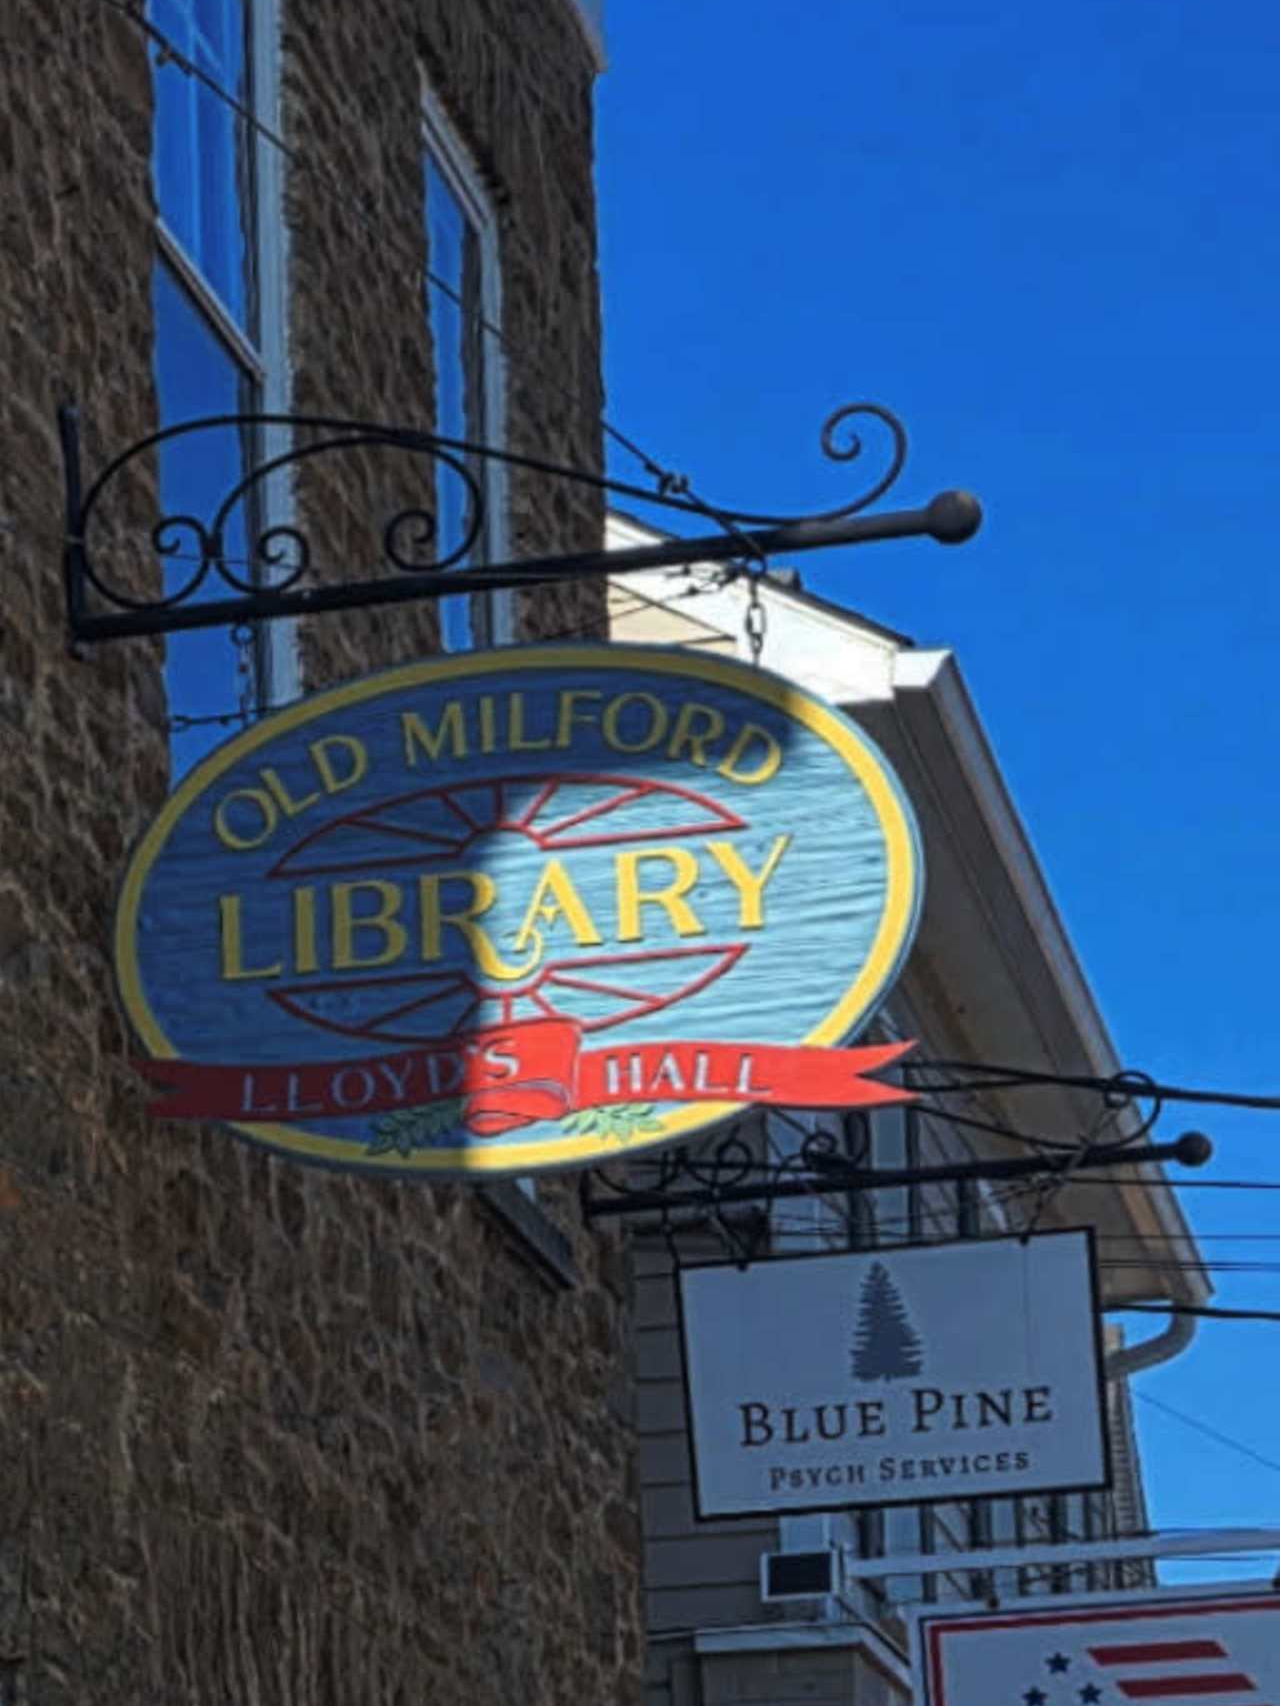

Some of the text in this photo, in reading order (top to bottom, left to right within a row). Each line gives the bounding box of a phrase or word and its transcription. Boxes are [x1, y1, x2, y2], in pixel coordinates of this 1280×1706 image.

[214, 690, 783, 851] OLD MILFORD
[217, 834, 792, 981] LIBRARY
[241, 1037, 773, 1113] LLOYD'S HALL
[739, 1385, 1053, 1447] BLUE PINE
[768, 1450, 1032, 1491] PSYCH SERVICES
